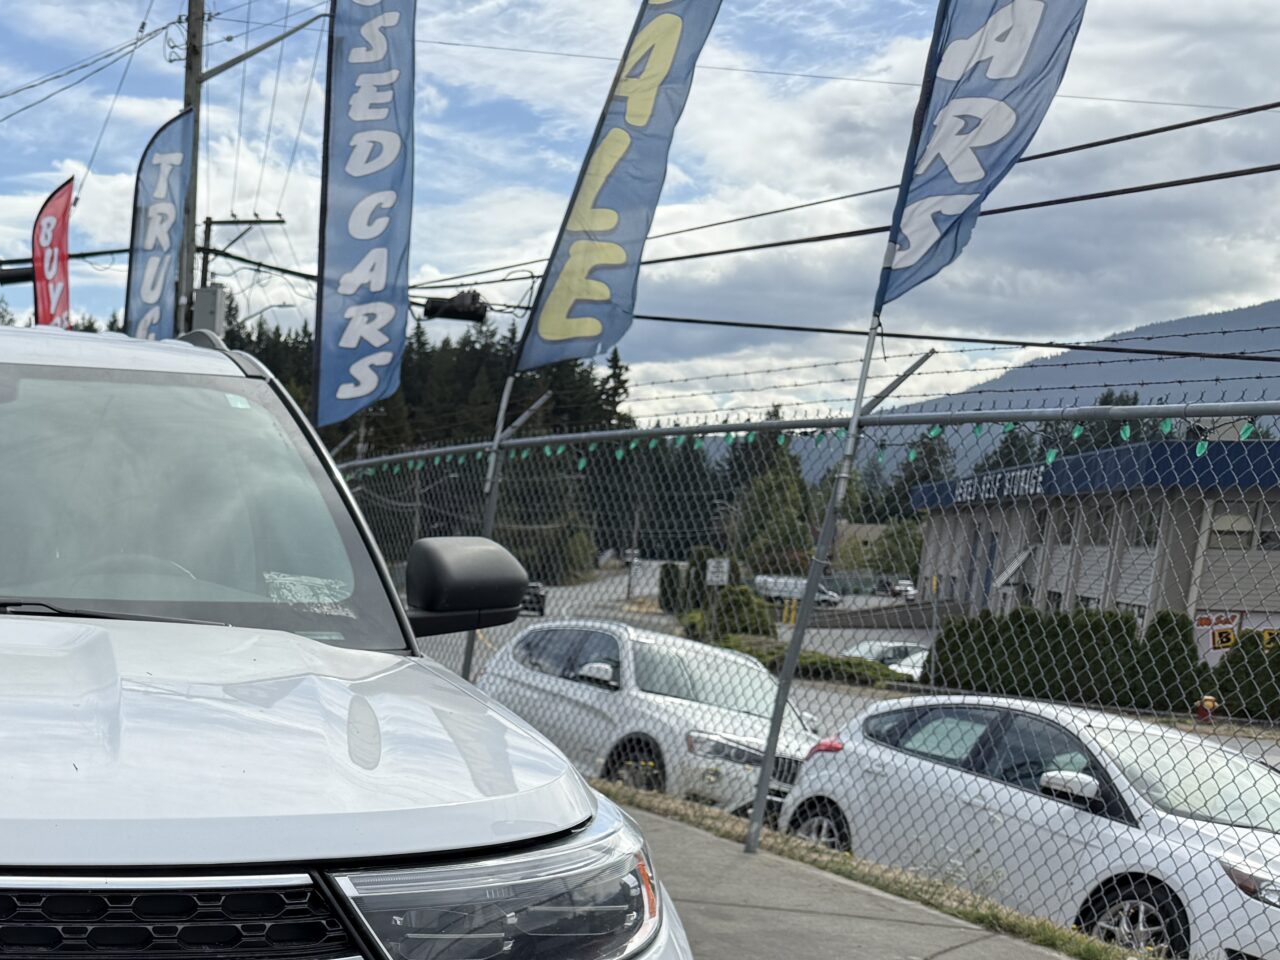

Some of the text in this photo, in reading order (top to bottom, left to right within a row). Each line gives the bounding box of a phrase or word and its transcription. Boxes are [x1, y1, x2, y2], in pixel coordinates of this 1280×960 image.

[39, 215, 65, 315] BUY
[336, 0, 402, 400] SED CARS
[537, 0, 685, 342] ALE
